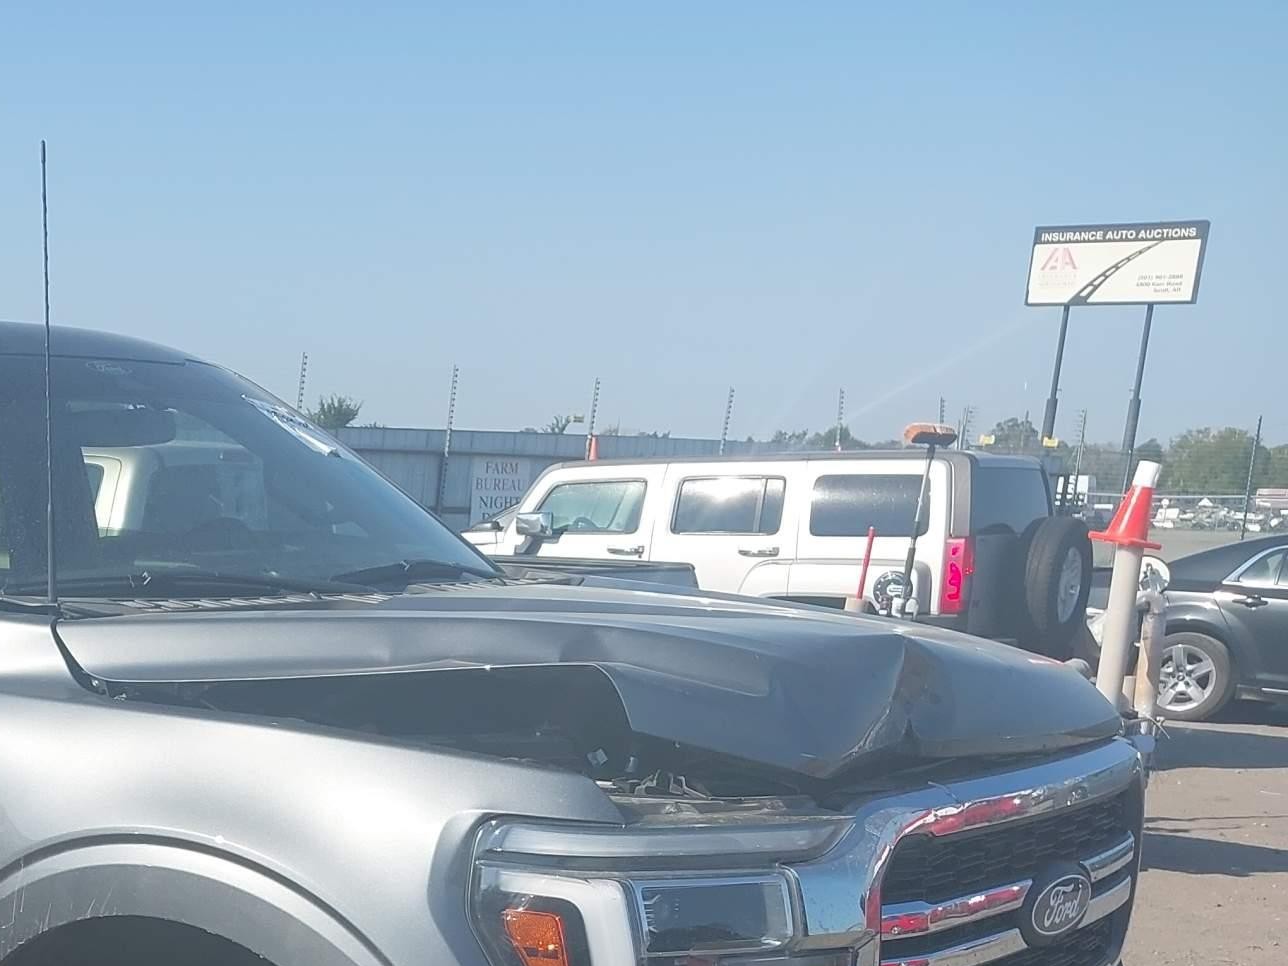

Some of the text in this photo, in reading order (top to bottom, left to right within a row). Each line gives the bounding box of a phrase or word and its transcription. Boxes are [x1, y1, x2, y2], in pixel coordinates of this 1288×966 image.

[1041, 227, 1197, 242] INSURANCE AUTO AUCTIONS
[485, 461, 519, 474] FARM
[475, 477, 522, 491] BUREAU
[479, 496, 521, 510] NIGHT
[1043, 879, 1083, 928] Ford
